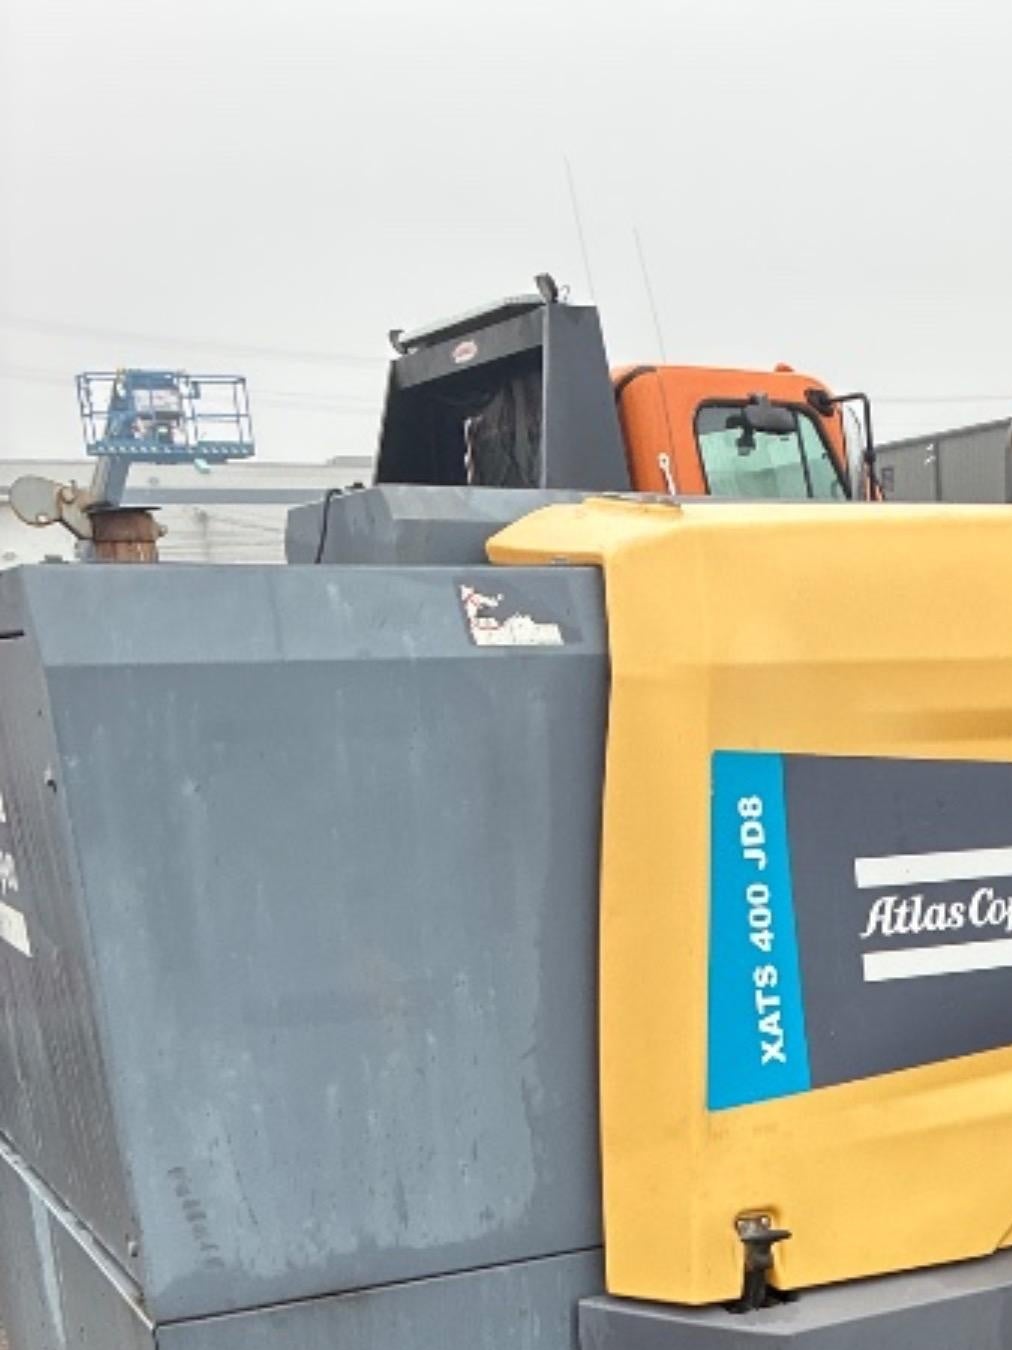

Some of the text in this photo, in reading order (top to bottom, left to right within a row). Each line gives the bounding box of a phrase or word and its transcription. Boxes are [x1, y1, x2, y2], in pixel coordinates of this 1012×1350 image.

[737, 795, 787, 1064] XATS 400 JD8
